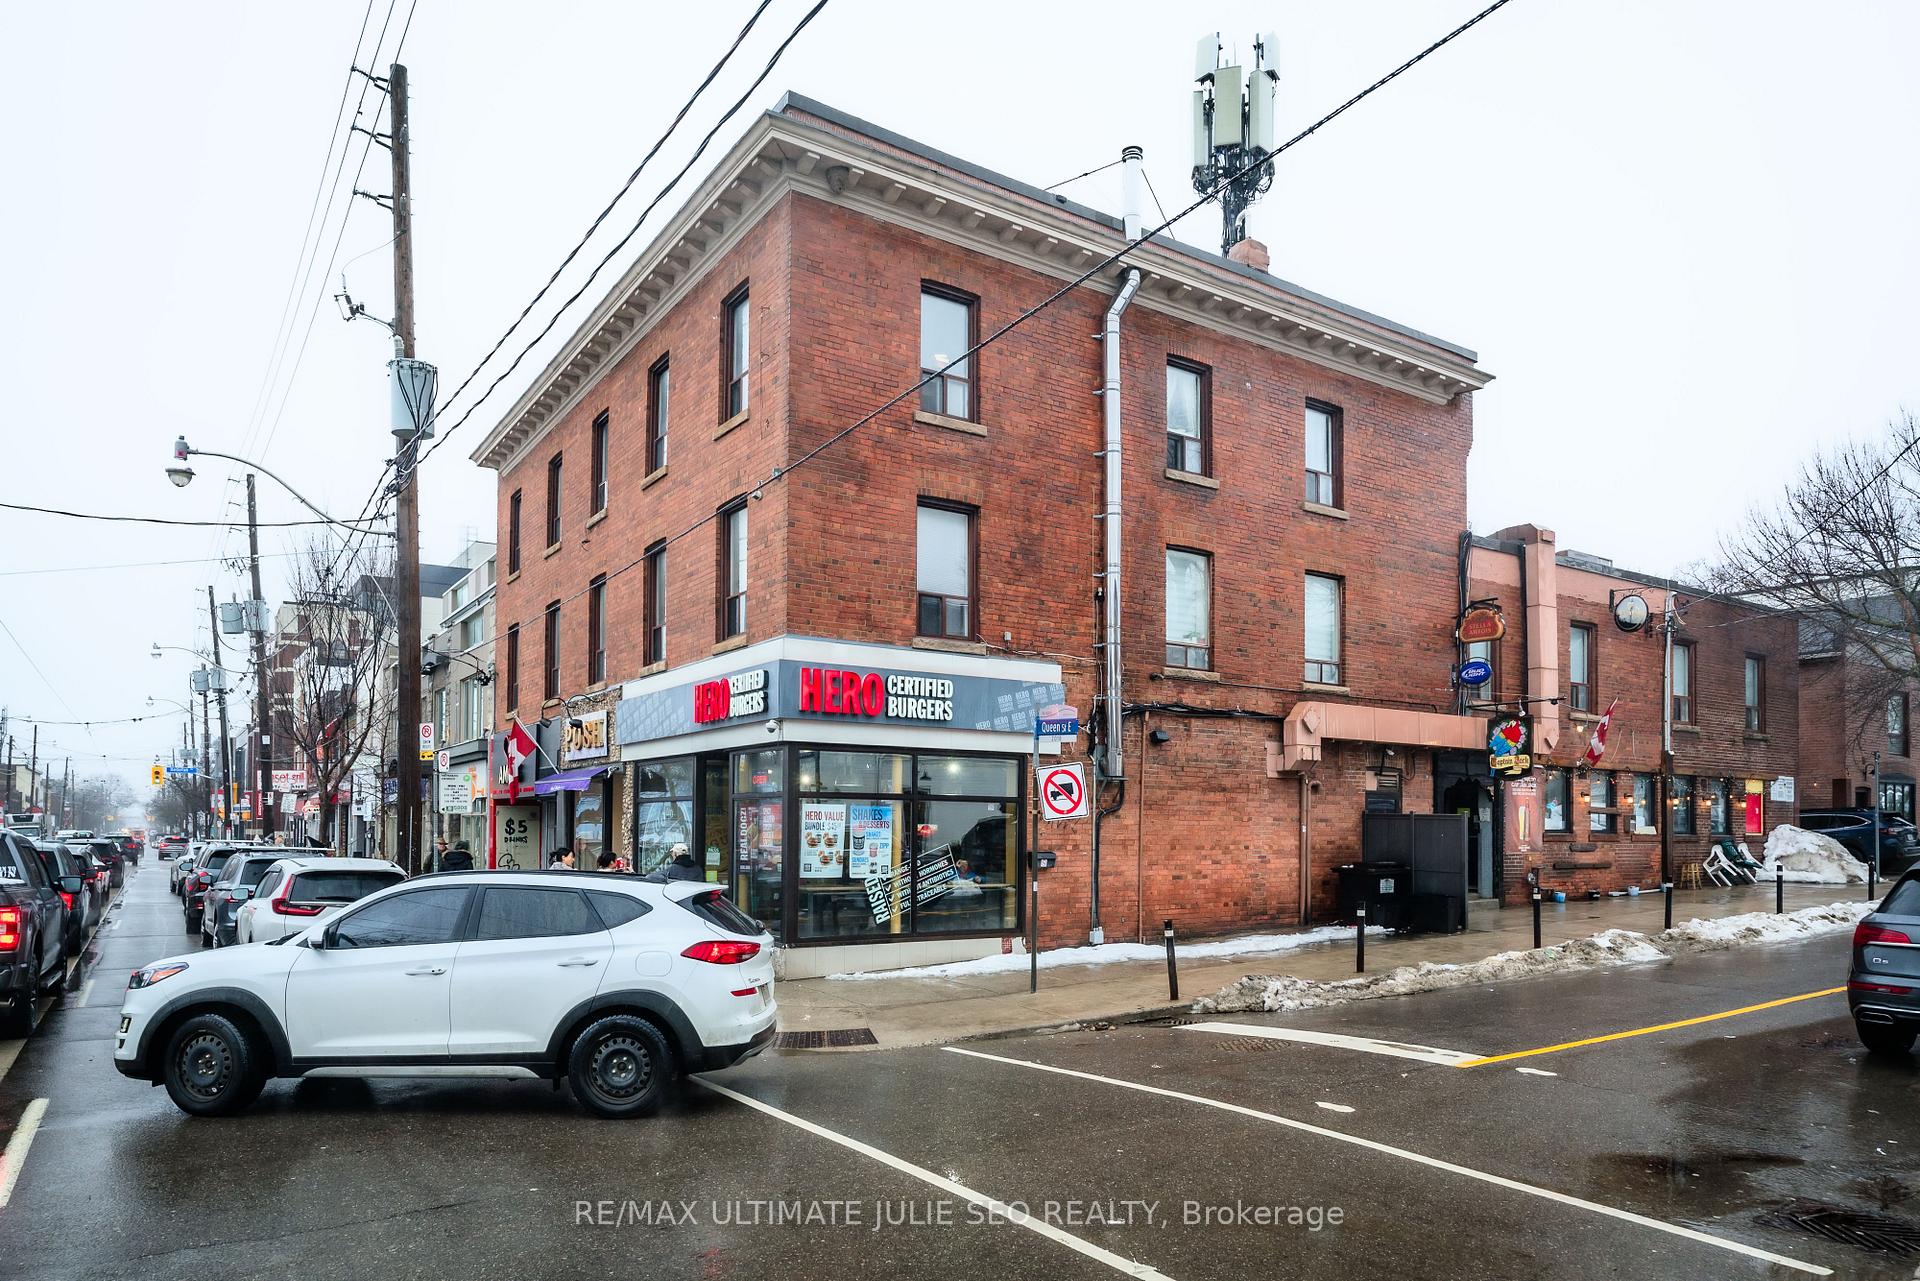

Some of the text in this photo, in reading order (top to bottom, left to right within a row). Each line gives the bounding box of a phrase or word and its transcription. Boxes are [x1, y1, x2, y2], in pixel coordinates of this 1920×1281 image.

[730, 669, 766, 695] CERTIFIED
[887, 674, 954, 698] CERTIFIED
[1032, 686, 1047, 696] HERO
[694, 677, 731, 724] HERO
[801, 667, 885, 717] HERO
[997, 694, 1013, 704] HERO
[1015, 690, 1030, 700] HERO
[730, 690, 766, 718] BURGERS
[887, 696, 953, 721] BURGERS
[976, 720, 991, 730] HERO
[993, 716, 1009, 726] HERO
[1041, 722, 1060, 733] Queen
[1067, 721, 1072, 732] E
[805, 810, 844, 821] HERO VALUE
[852, 808, 883, 821] SHAKES
[504, 817, 528, 835] $5
[804, 821, 825, 831] BUNDLE
[863, 820, 890, 829] DESSERTS
[740, 837, 749, 861] REAL
[919, 859, 949, 877] HORMONES
[922, 868, 954, 888] ANTIBIOTICS
[864, 877, 891, 925] RAISED
